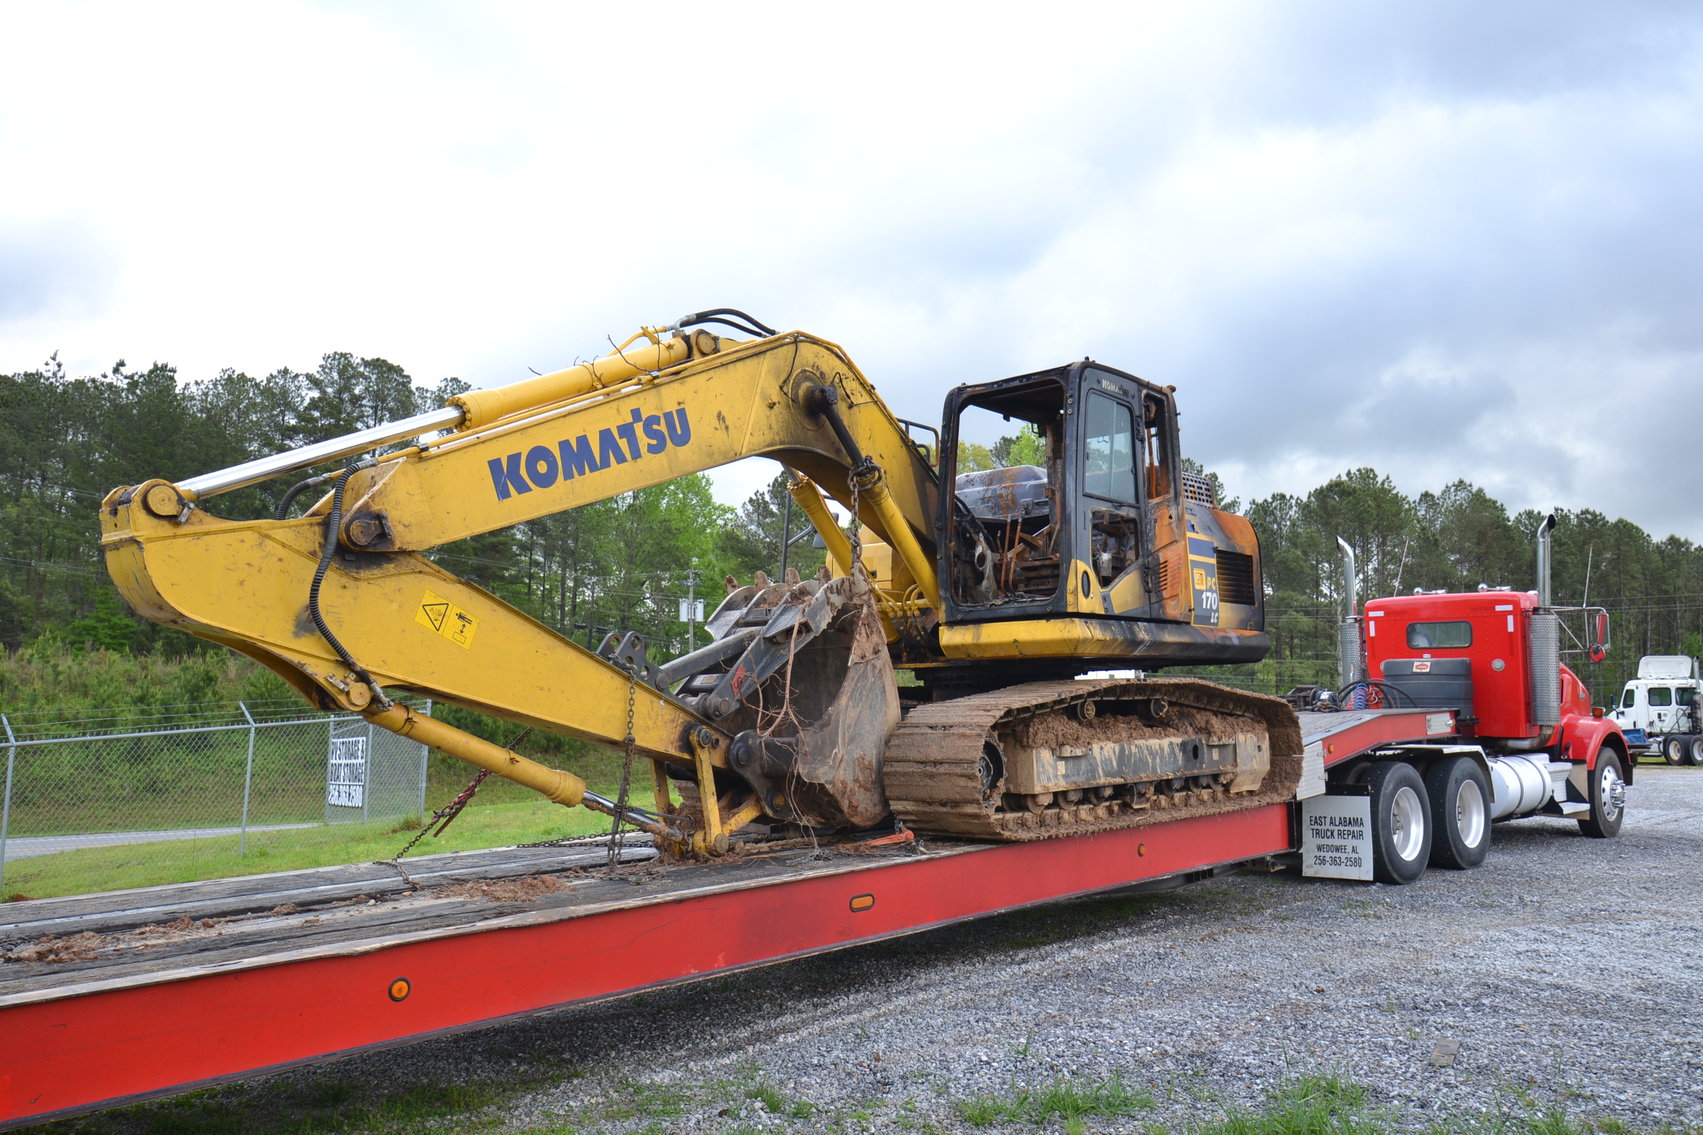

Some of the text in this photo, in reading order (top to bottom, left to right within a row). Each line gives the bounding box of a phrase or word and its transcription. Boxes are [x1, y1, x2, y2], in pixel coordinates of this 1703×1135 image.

[487, 407, 691, 501] KOMATSU
[1206, 576, 1216, 590] PC
[1202, 591, 1218, 610] 170
[338, 739, 360, 760] STORAGE
[330, 762, 364, 783] BOAT STORAGE
[1309, 815, 1364, 827] EAST ALABAMA
[1311, 828, 1364, 840] TRUCK REPAIR
[1316, 843, 1359, 855] WEDOWEE, AL
[1313, 855, 1362, 868] 256-363-2580
